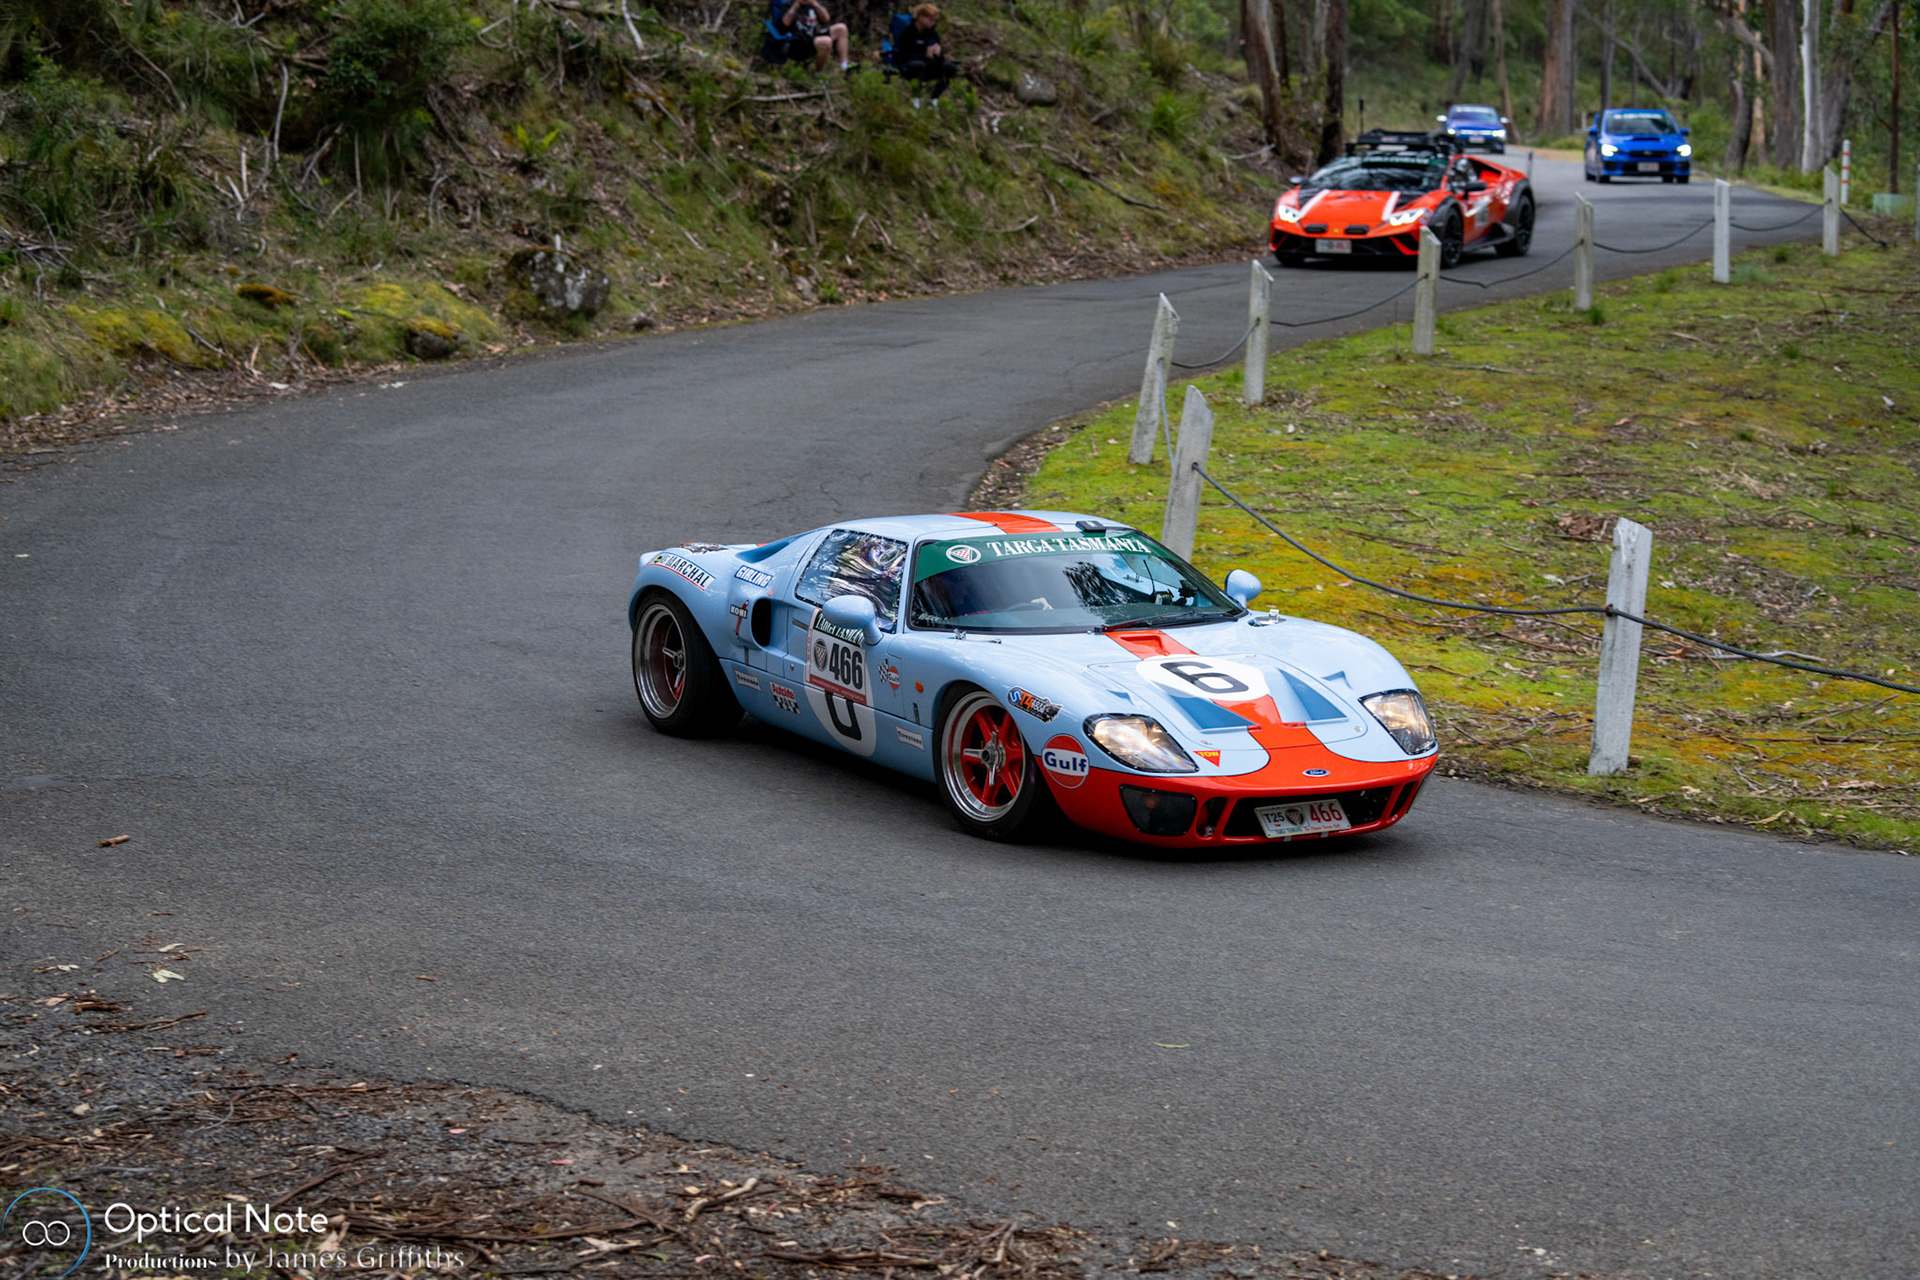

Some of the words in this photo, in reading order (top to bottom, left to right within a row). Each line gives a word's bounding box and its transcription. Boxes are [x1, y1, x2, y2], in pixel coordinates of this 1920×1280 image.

[986, 540, 1056, 557] TARGA
[1051, 536, 1152, 554] TASMANIA
[666, 555, 710, 587] MARCHAL
[736, 566, 772, 588] GIRLING
[730, 605, 748, 618] KONI
[829, 643, 863, 690] 466
[1160, 661, 1249, 694] 6
[1044, 751, 1087, 772] Gulf
[1264, 812, 1285, 823] T25
[1309, 802, 1343, 823] 466
